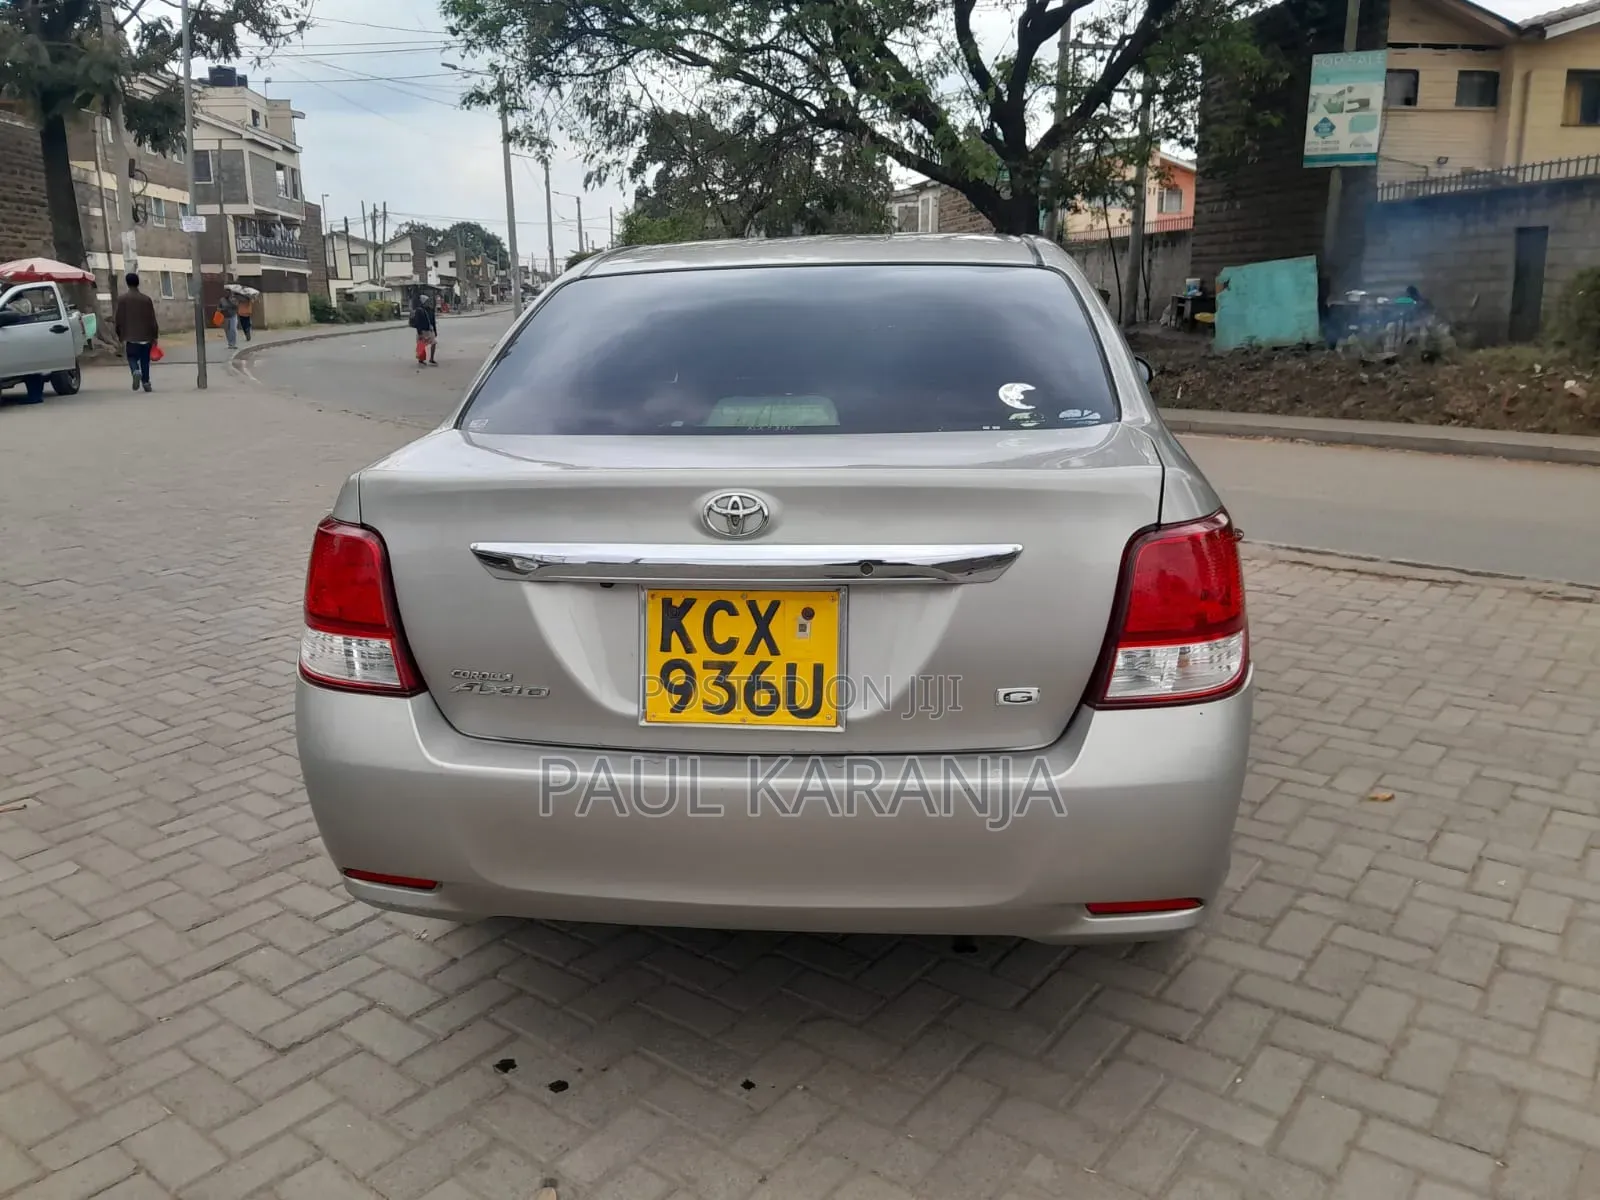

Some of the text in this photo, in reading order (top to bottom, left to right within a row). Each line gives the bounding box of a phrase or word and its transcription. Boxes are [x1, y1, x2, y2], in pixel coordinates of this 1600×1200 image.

[660, 597, 781, 656] KCX
[659, 658, 824, 719] 936U
[1003, 691, 1032, 703] G
